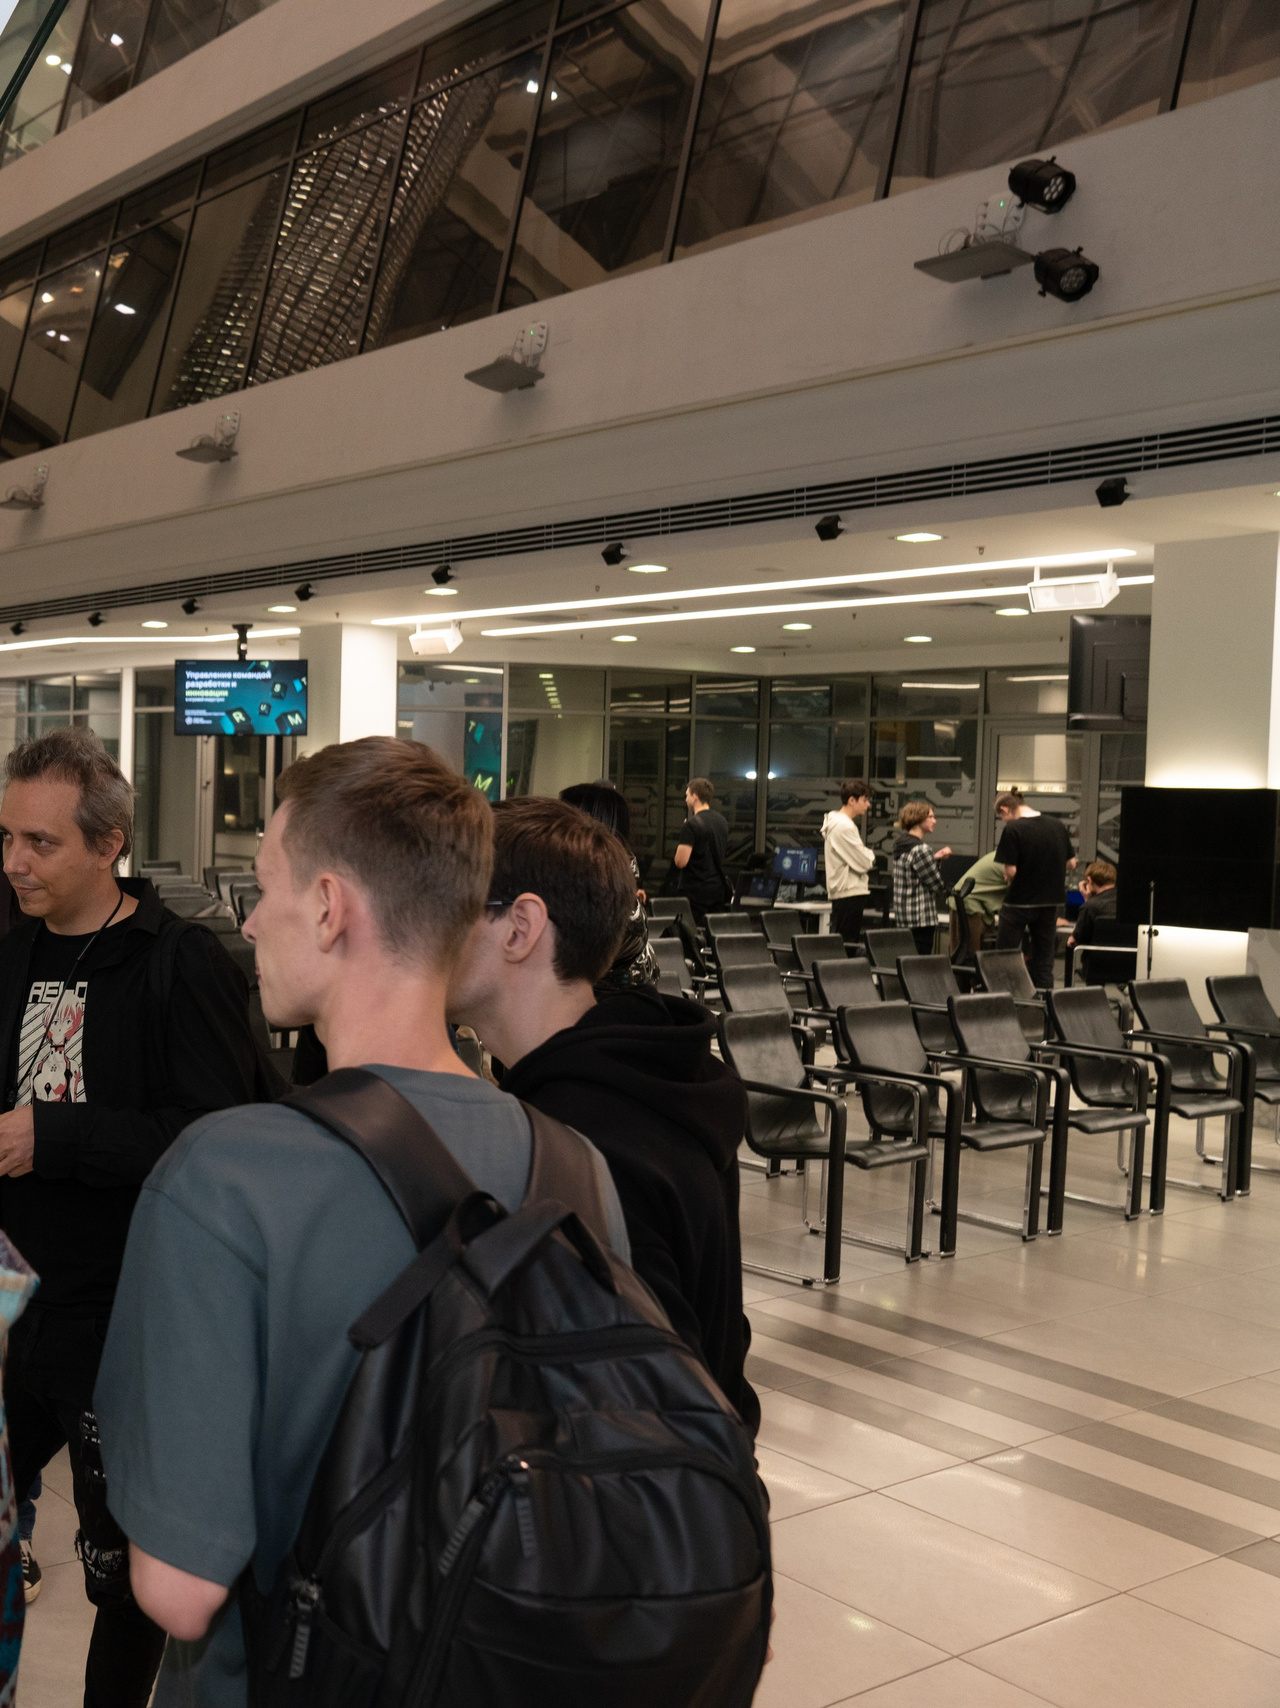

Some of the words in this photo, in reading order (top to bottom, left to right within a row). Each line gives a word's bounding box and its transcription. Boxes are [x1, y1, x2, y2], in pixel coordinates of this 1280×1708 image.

[186, 671, 232, 680] Управление
[233, 670, 271, 680] командой
[186, 681, 230, 689] разработки
[232, 711, 246, 724] R
[287, 713, 303, 726] M
